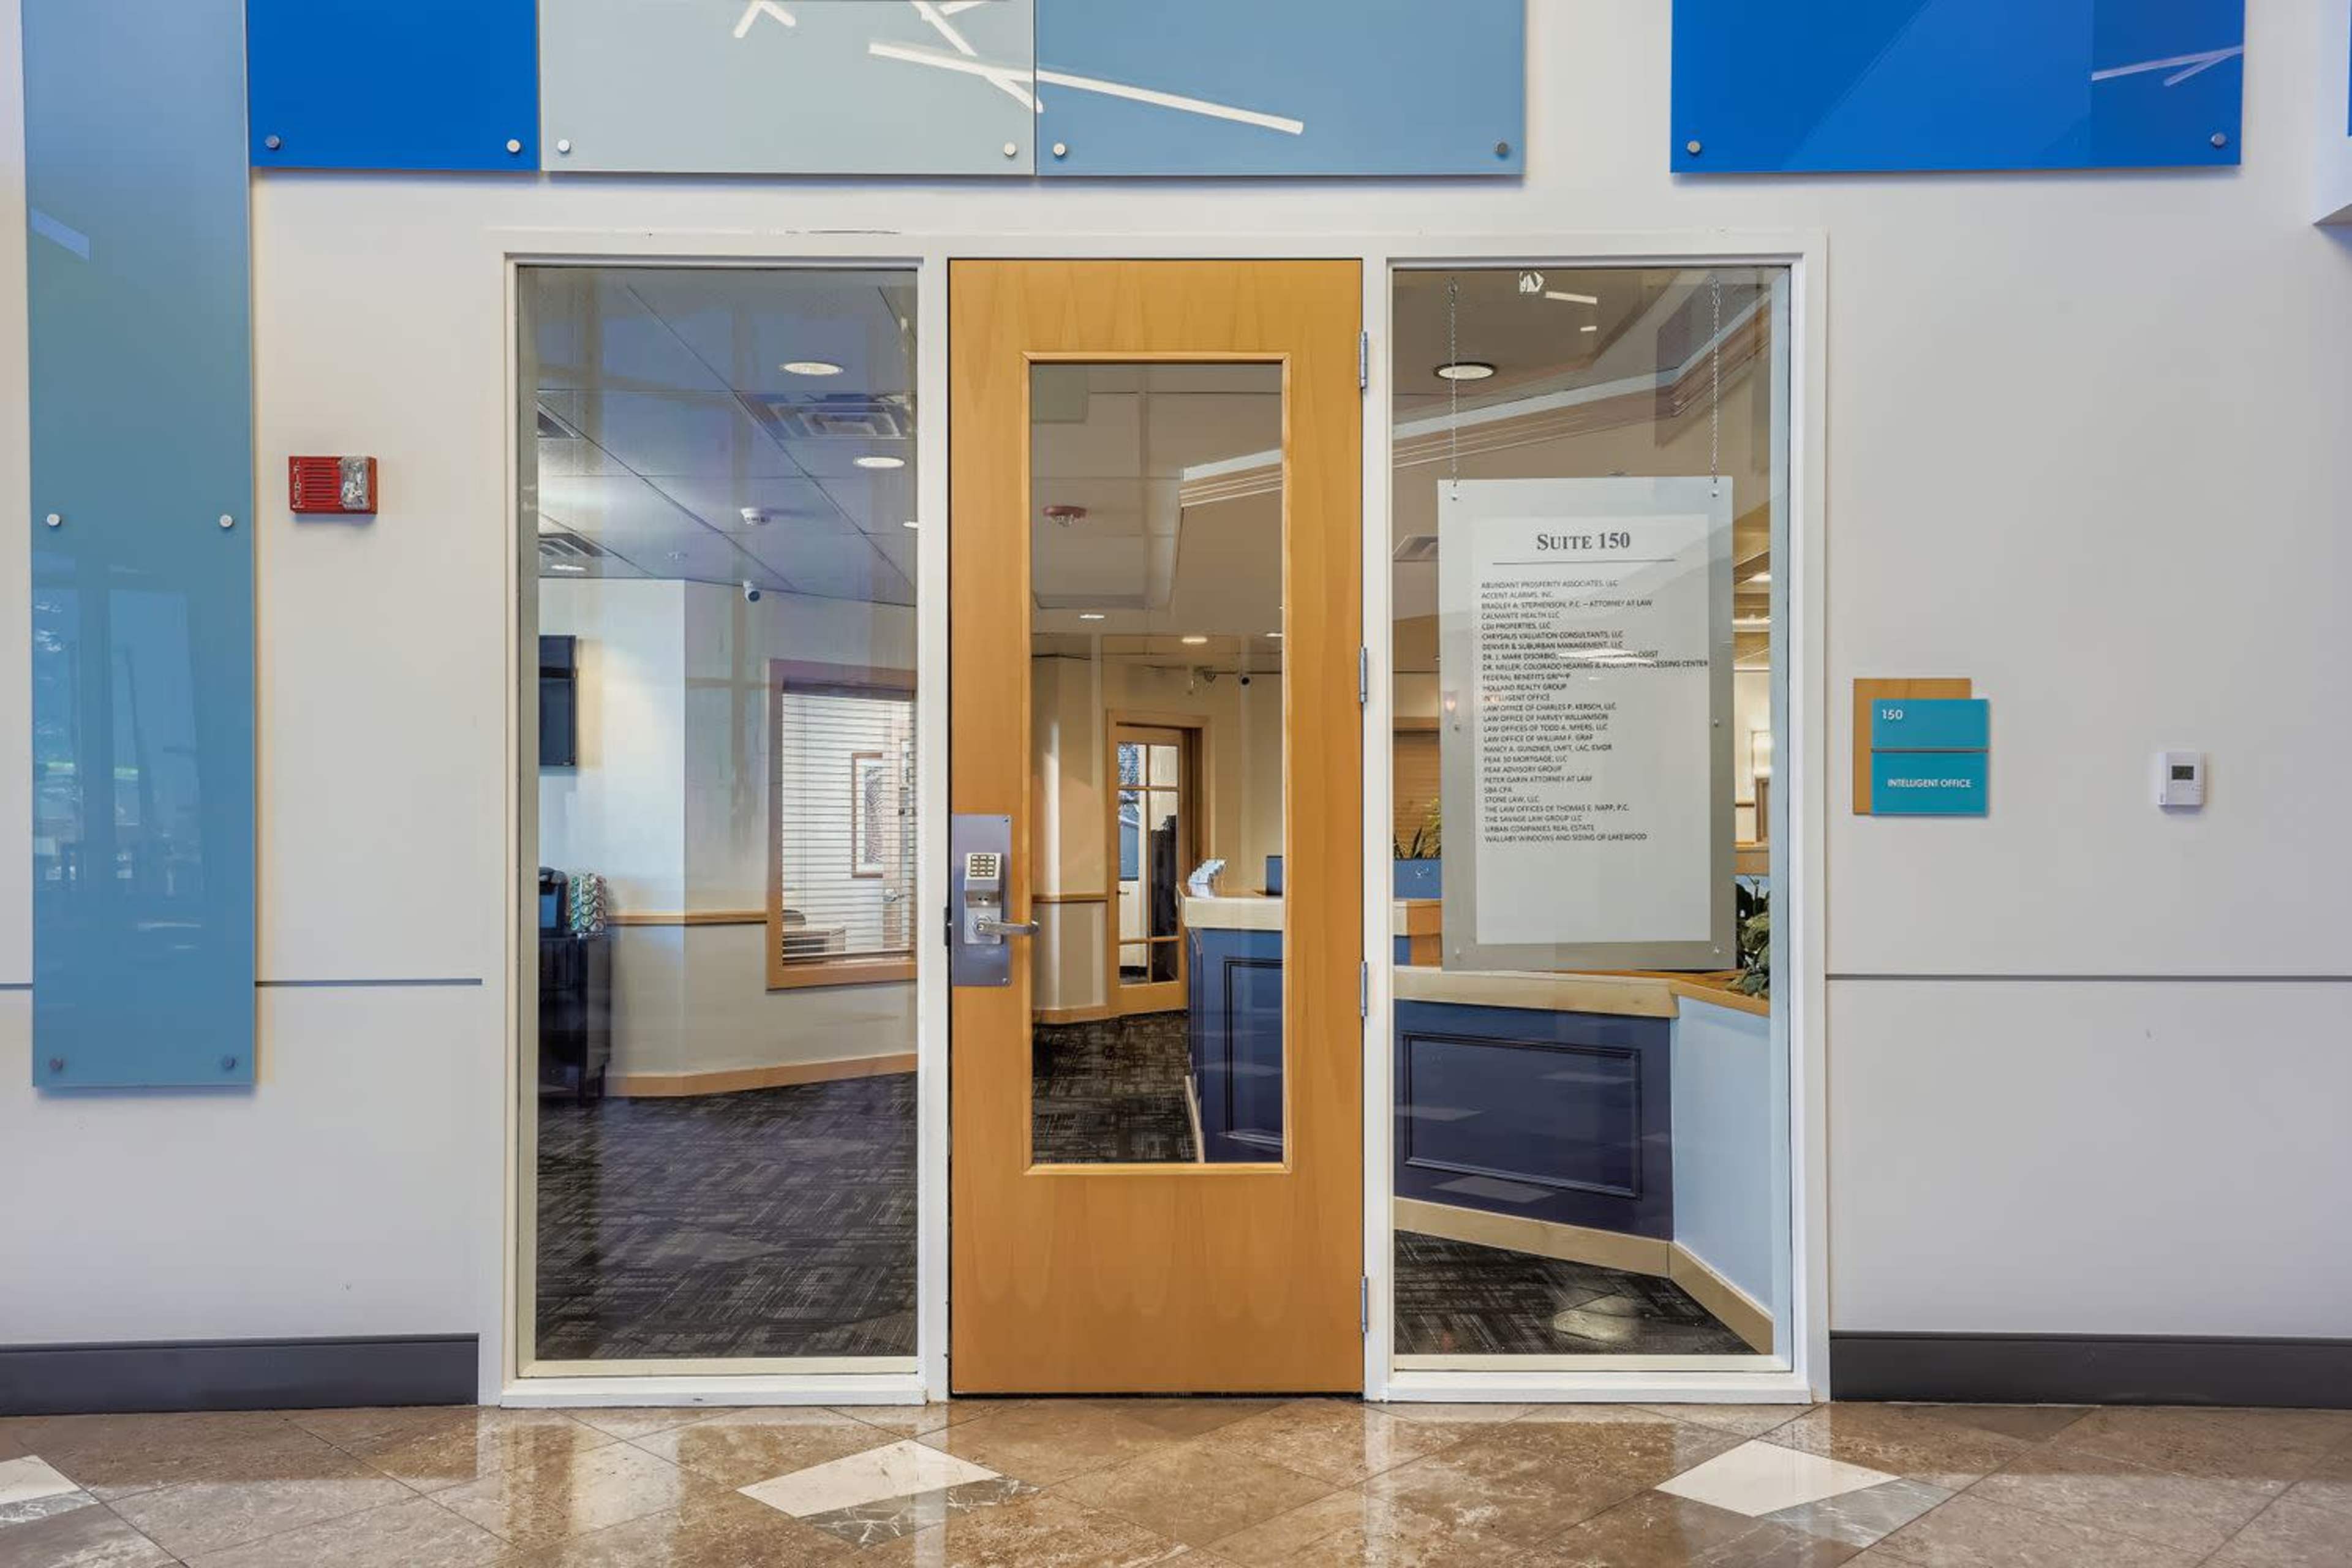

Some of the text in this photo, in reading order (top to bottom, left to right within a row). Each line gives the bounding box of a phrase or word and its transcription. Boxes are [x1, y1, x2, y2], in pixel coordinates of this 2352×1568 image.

[1537, 532, 1630, 551] SUITE 150
[1882, 709, 1903, 720] 150
[1887, 778, 1971, 788] INTELLIGENT OFFICE
